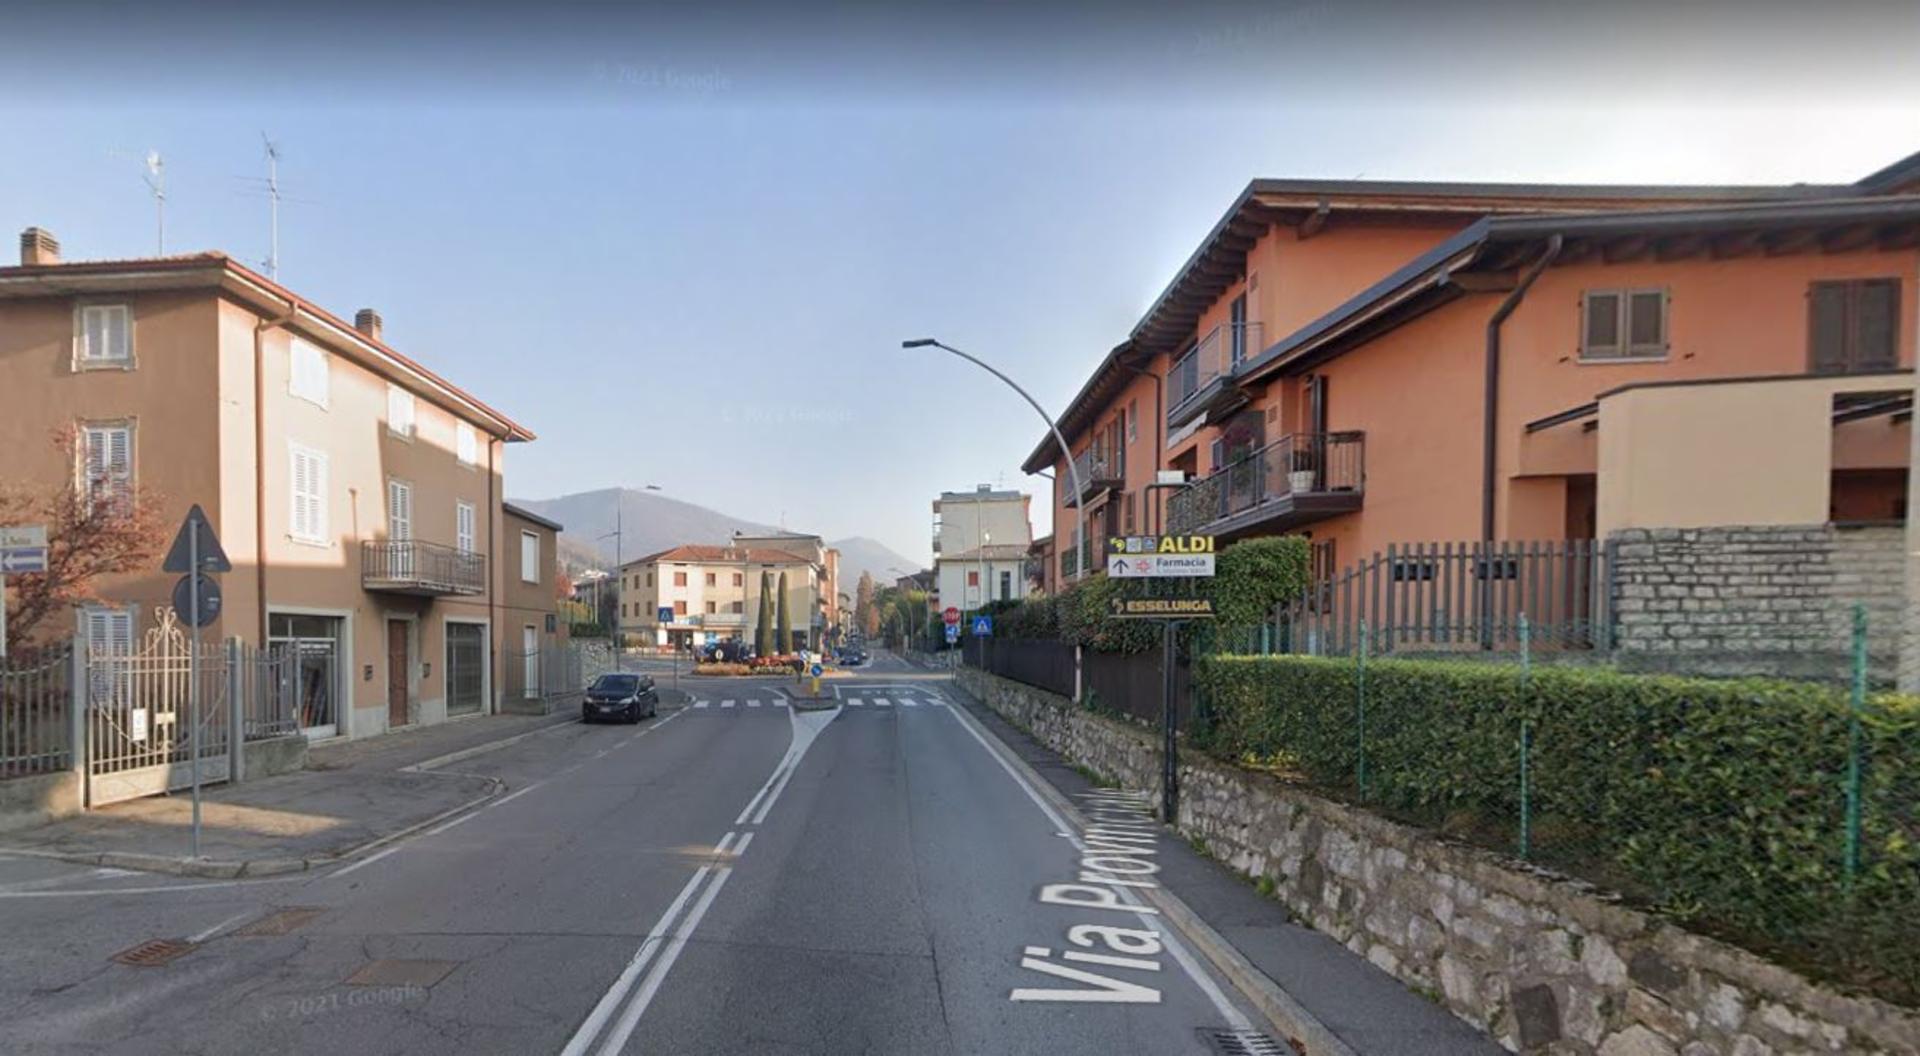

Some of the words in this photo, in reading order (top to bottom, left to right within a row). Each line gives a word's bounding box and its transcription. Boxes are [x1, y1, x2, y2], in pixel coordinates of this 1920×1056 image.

[1159, 535, 1214, 553] ALDI
[1156, 557, 1207, 567] Farmacia
[1126, 600, 1212, 612] ESSELUNGA
